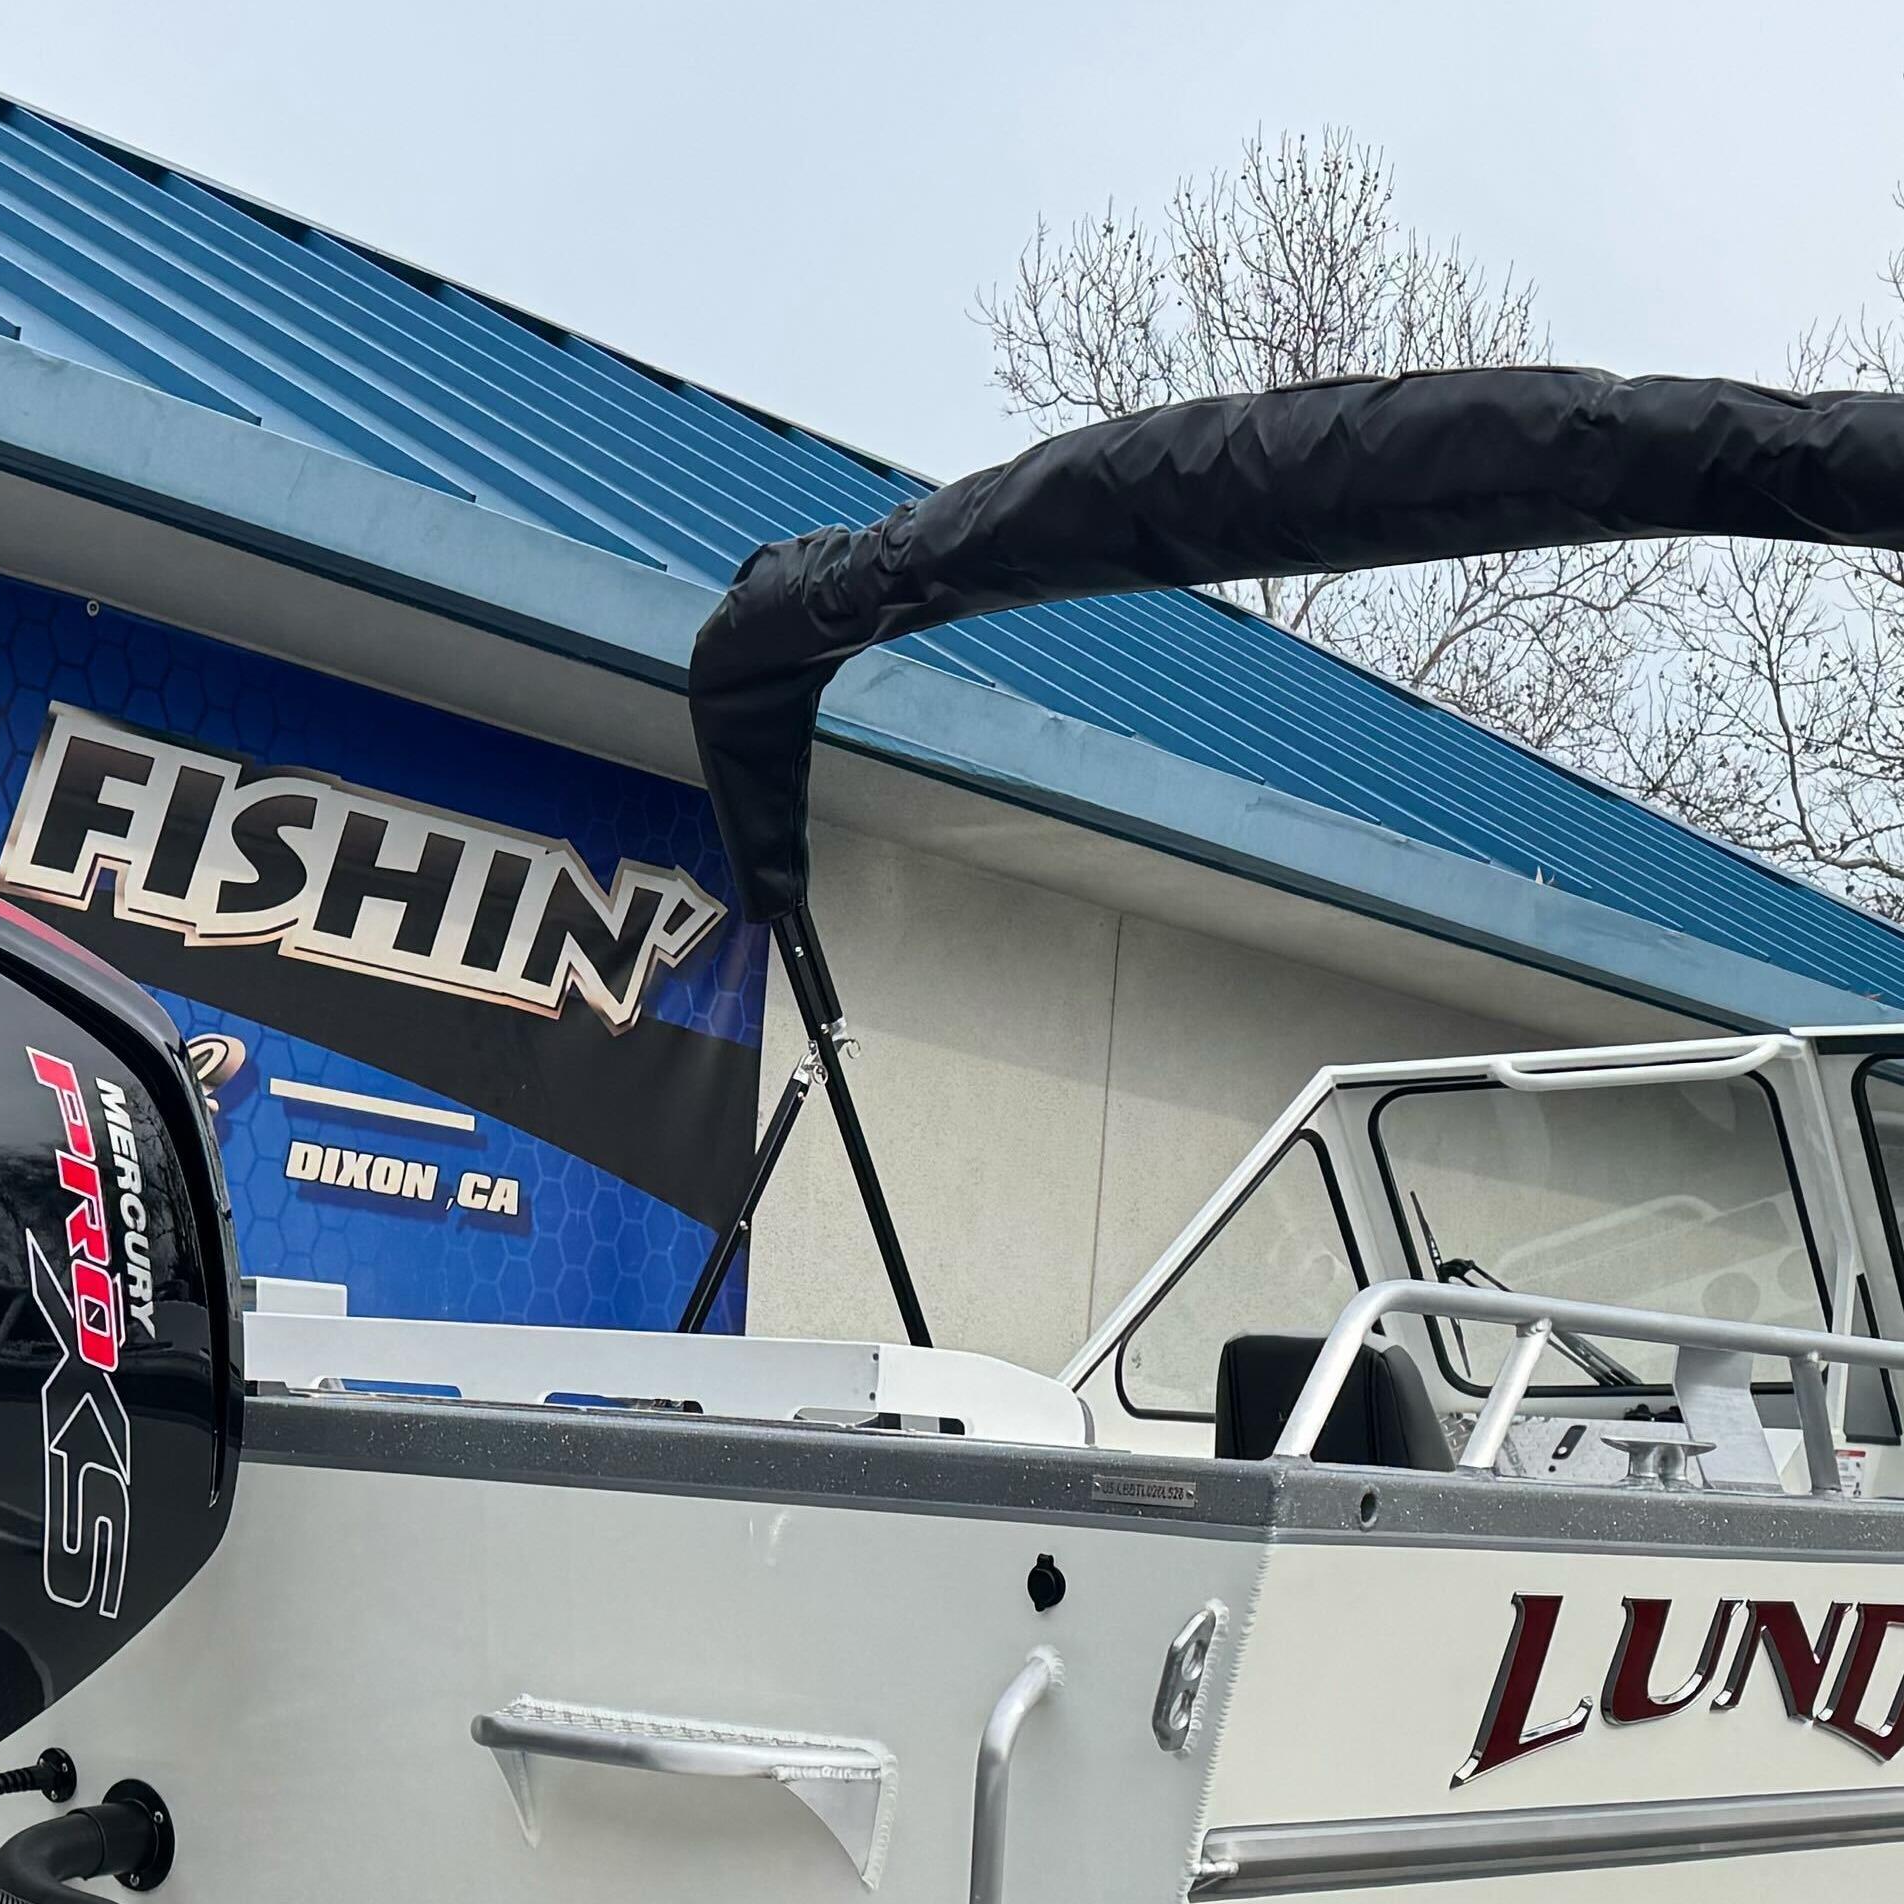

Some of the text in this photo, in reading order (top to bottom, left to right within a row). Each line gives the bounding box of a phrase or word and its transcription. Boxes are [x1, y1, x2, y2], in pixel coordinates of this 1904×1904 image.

[2, 712, 720, 1028] FISHIN'
[95, 1076, 157, 1340] MERCURY
[283, 1139, 440, 1203] DIXON
[24, 1044, 131, 1620] PRO XS
